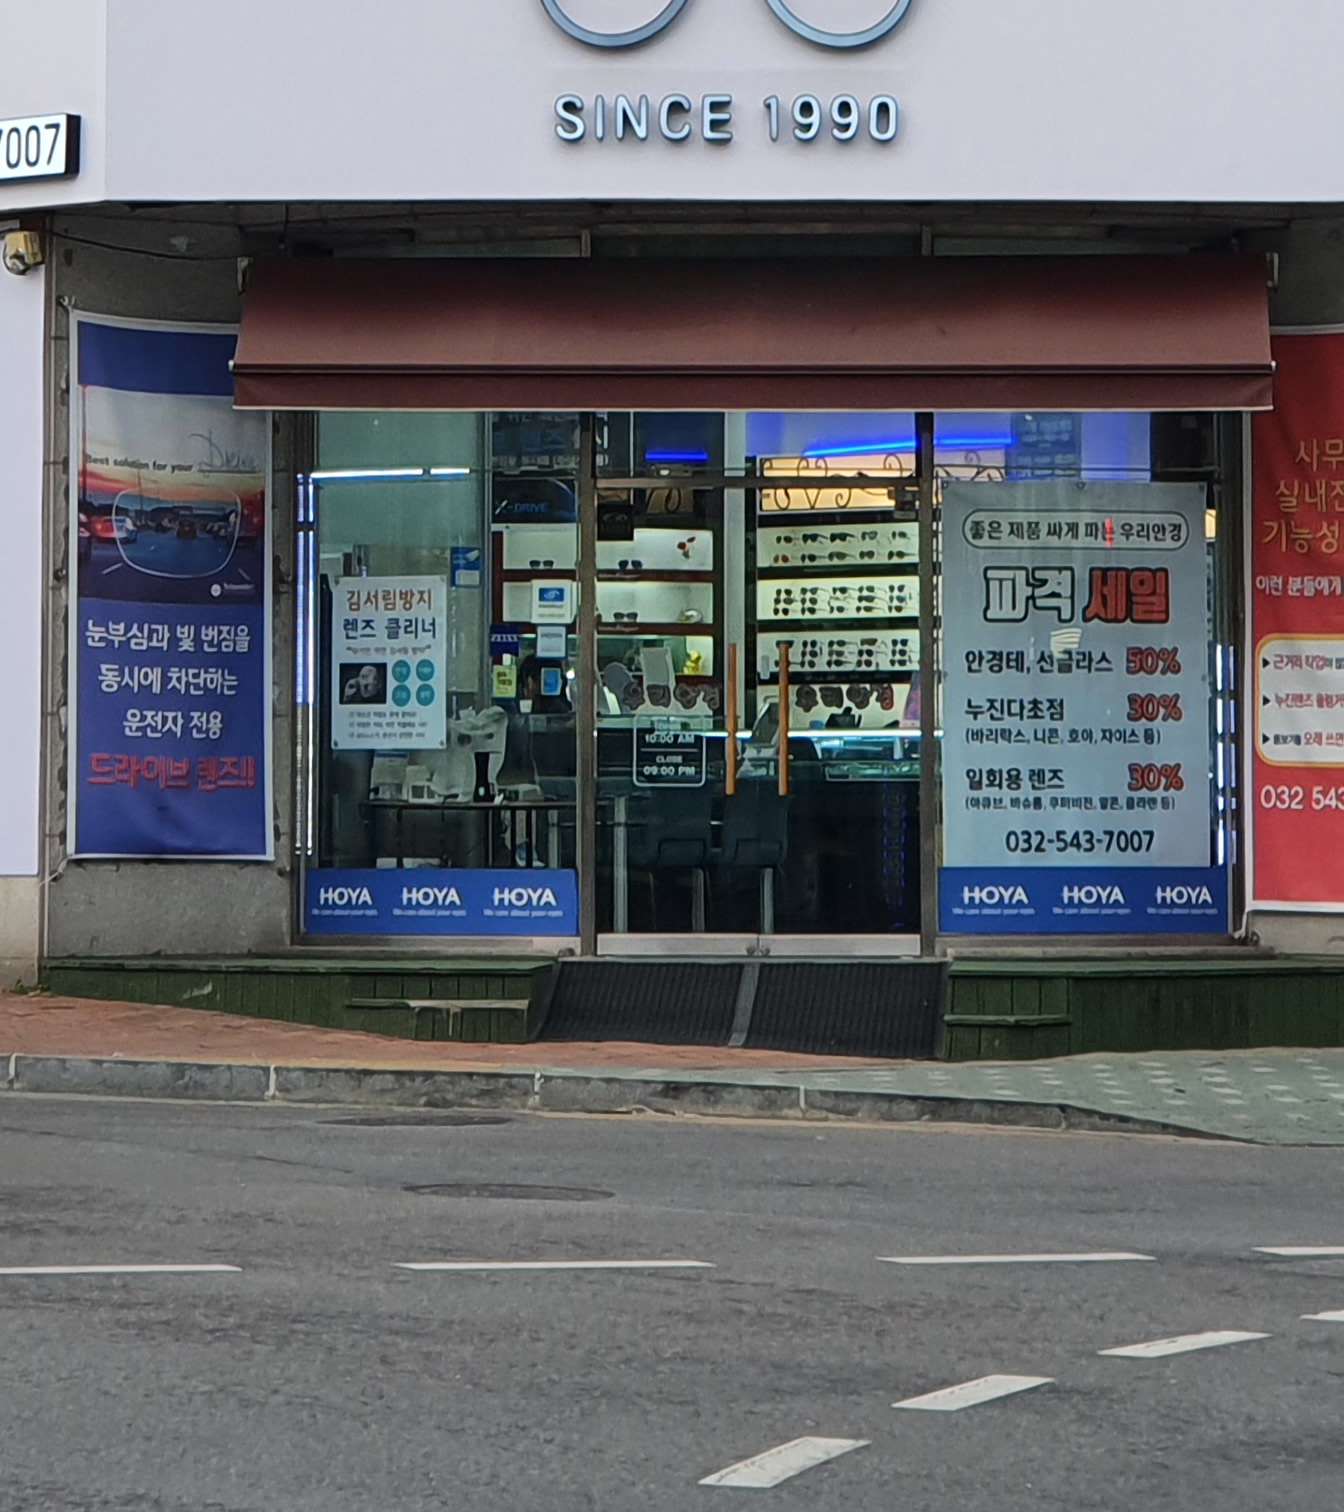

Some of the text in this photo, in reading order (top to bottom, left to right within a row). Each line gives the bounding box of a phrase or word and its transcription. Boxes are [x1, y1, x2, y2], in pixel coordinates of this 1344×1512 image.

[554, 94, 900, 143] SINCE 1990
[970, 520, 1003, 541] 좋은
[1007, 520, 1041, 541] 제품
[1045, 521, 1079, 541] 싸게
[1119, 522, 1182, 542] 우리안경
[1262, 519, 1341, 554] 기능성
[346, 589, 432, 612] 김서림방지
[982, 565, 1171, 624] 파격 세일
[85, 619, 251, 652] 눈부심과 빛 번짐을
[343, 616, 436, 640] 렌즈 클리너
[965, 649, 1031, 675] 안경테,
[1125, 646, 1182, 676] 50%
[98, 663, 238, 695] 동시에 차단하는
[965, 692, 1184, 723] 누진다초점 30%
[123, 708, 223, 739] 운전자 전용
[965, 762, 1185, 793] 일회용 렌즈 30%
[1260, 784, 1304, 810] 032
[1005, 829, 1155, 854] 032-543-7007
[319, 887, 373, 906] HOYA
[401, 887, 461, 906] HOYA
[493, 887, 557, 906] HOYA
[962, 886, 1029, 905] HOYA
[1062, 886, 1125, 905] HOYA
[1155, 886, 1213, 905] HOYA
